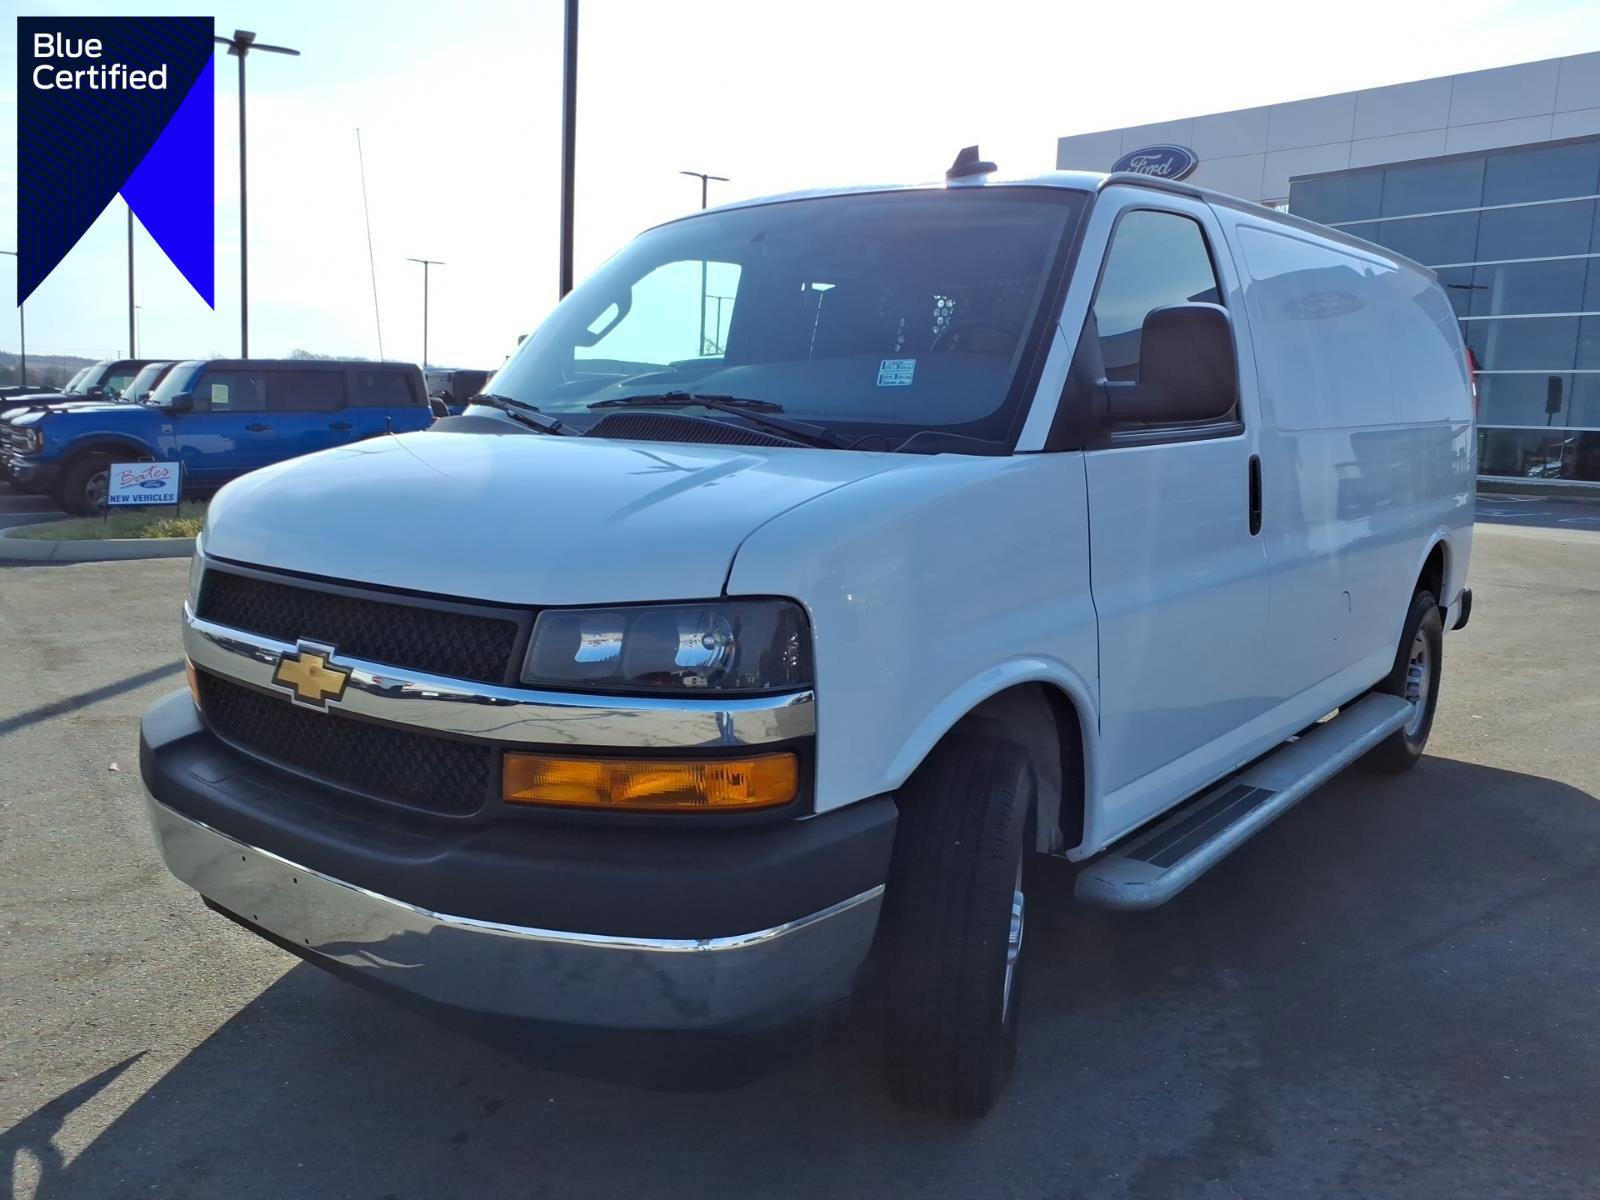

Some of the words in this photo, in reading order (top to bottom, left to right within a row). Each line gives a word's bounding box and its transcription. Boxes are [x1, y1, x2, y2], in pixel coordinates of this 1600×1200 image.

[1127, 154, 1173, 176] Ford
[117, 465, 170, 485] Bates
[110, 494, 130, 503] NEW
[132, 493, 175, 503] VEHICLES
